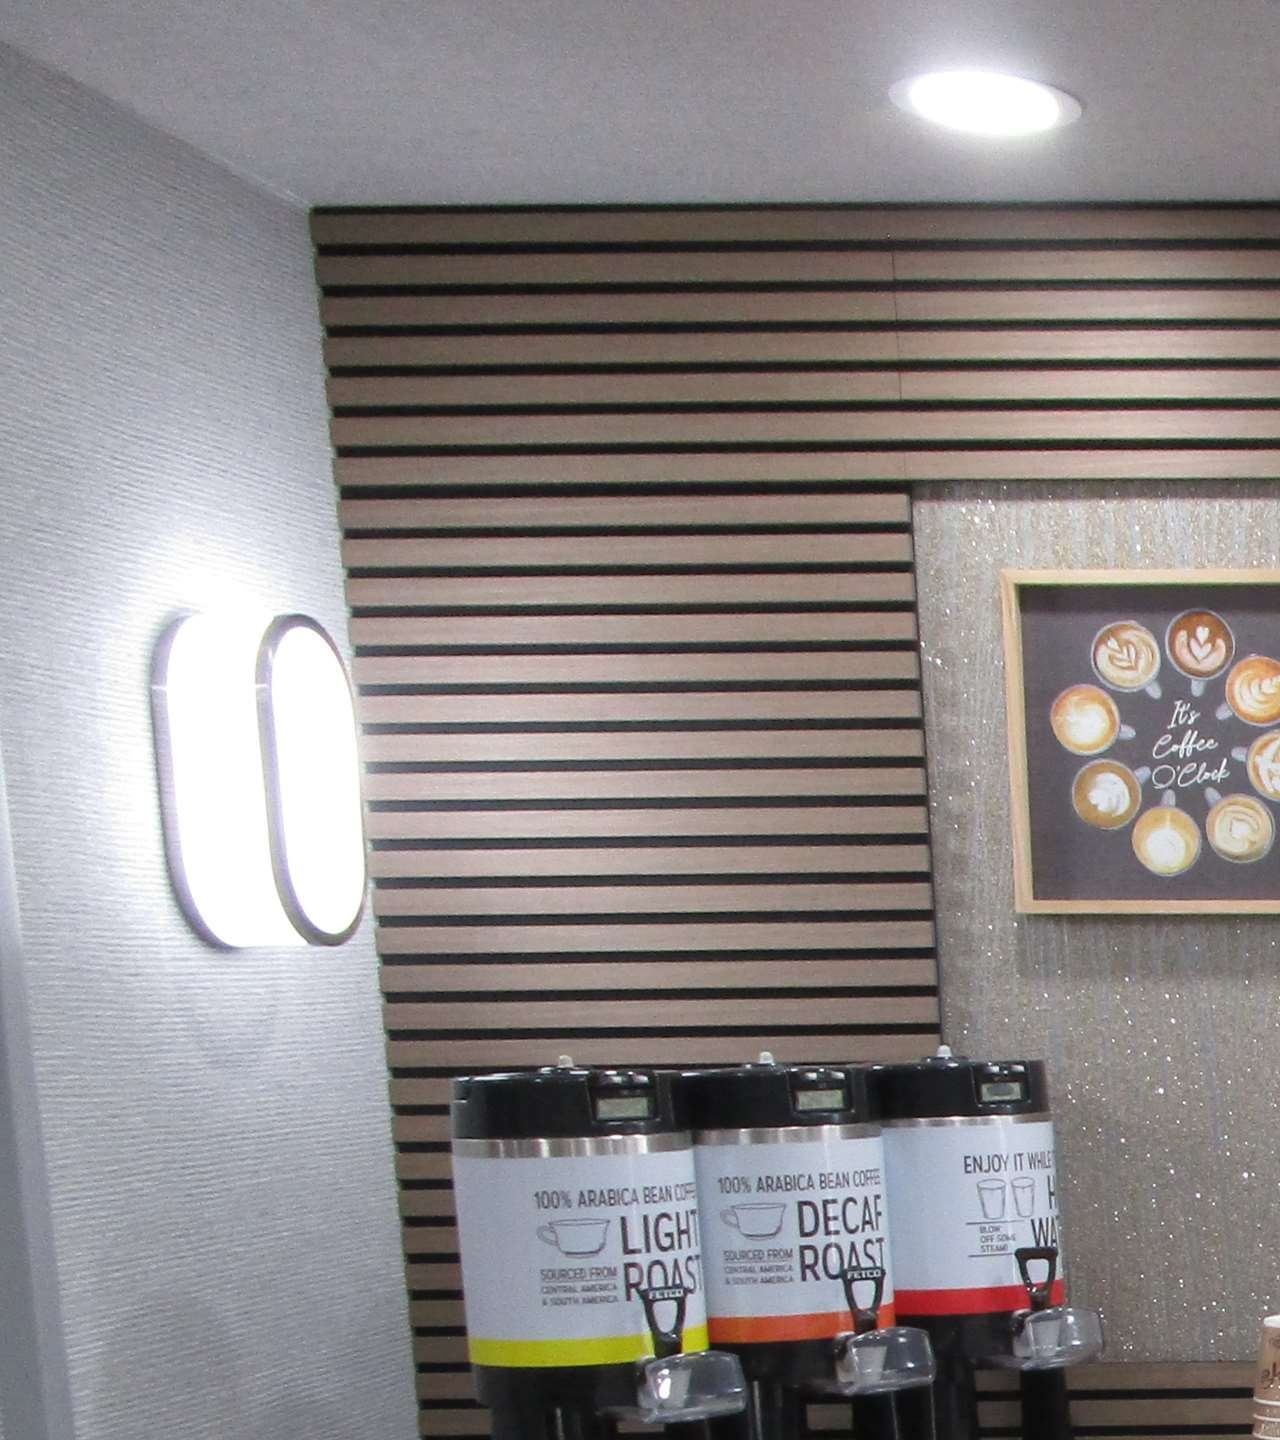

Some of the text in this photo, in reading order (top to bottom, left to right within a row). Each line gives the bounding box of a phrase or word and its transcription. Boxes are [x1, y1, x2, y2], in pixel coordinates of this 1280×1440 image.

[1167, 700, 1200, 729] It's
[1152, 729, 1219, 759] Coffee
[1152, 758, 1231, 789] O'Clock
[964, 1153, 1009, 1174] ENJOY
[1014, 1153, 1025, 1172] IT
[534, 1190, 572, 1210] 100%
[577, 1188, 640, 1208] ARABICA
[643, 1184, 673, 1204] BEAN
[718, 1177, 752, 1194] 100%
[756, 1175, 815, 1193] ARABICA
[819, 1171, 850, 1190] BEAN
[798, 1194, 883, 1238] DECAF
[620, 1209, 700, 1255] LIGHT
[724, 1248, 794, 1262] SOURCED FROM
[799, 1238, 885, 1282] ROAST
[540, 1266, 618, 1282] SOURCED FROM
[624, 1254, 702, 1301] ROAST
